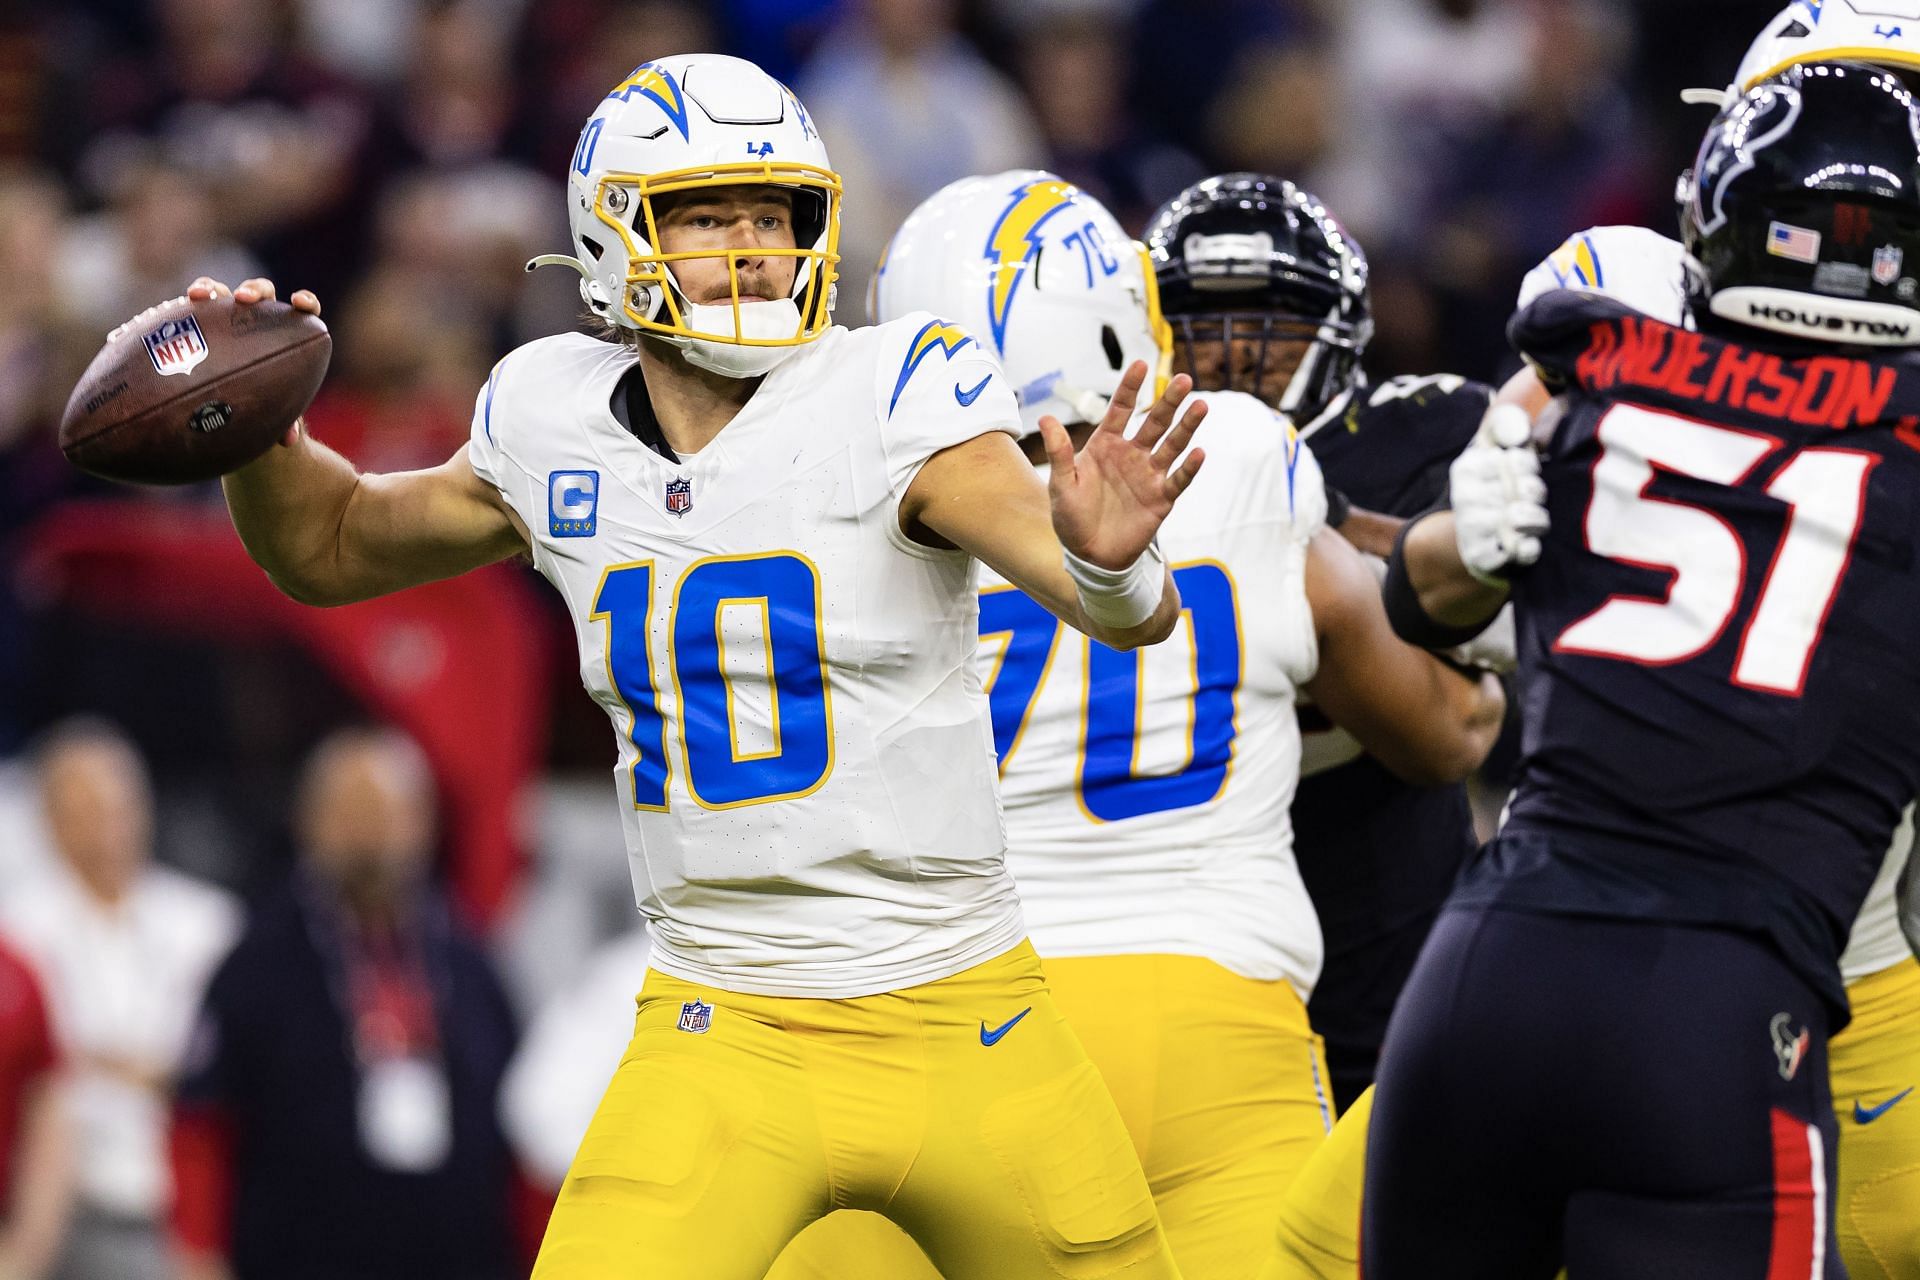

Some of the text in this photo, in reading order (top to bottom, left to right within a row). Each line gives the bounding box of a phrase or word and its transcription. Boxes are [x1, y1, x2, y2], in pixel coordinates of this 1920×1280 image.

[573, 117, 605, 177] 10
[747, 141, 774, 160] LA
[1749, 303, 1910, 338] HOUSTON
[154, 335, 201, 367] NFL
[1575, 315, 1897, 430] ANDERSON
[552, 475, 594, 520] C
[668, 493, 689, 510] NFL
[1552, 401, 1883, 698] 51
[589, 549, 836, 814] 10
[978, 556, 1246, 825] 70
[682, 1014, 705, 1029] NFL
